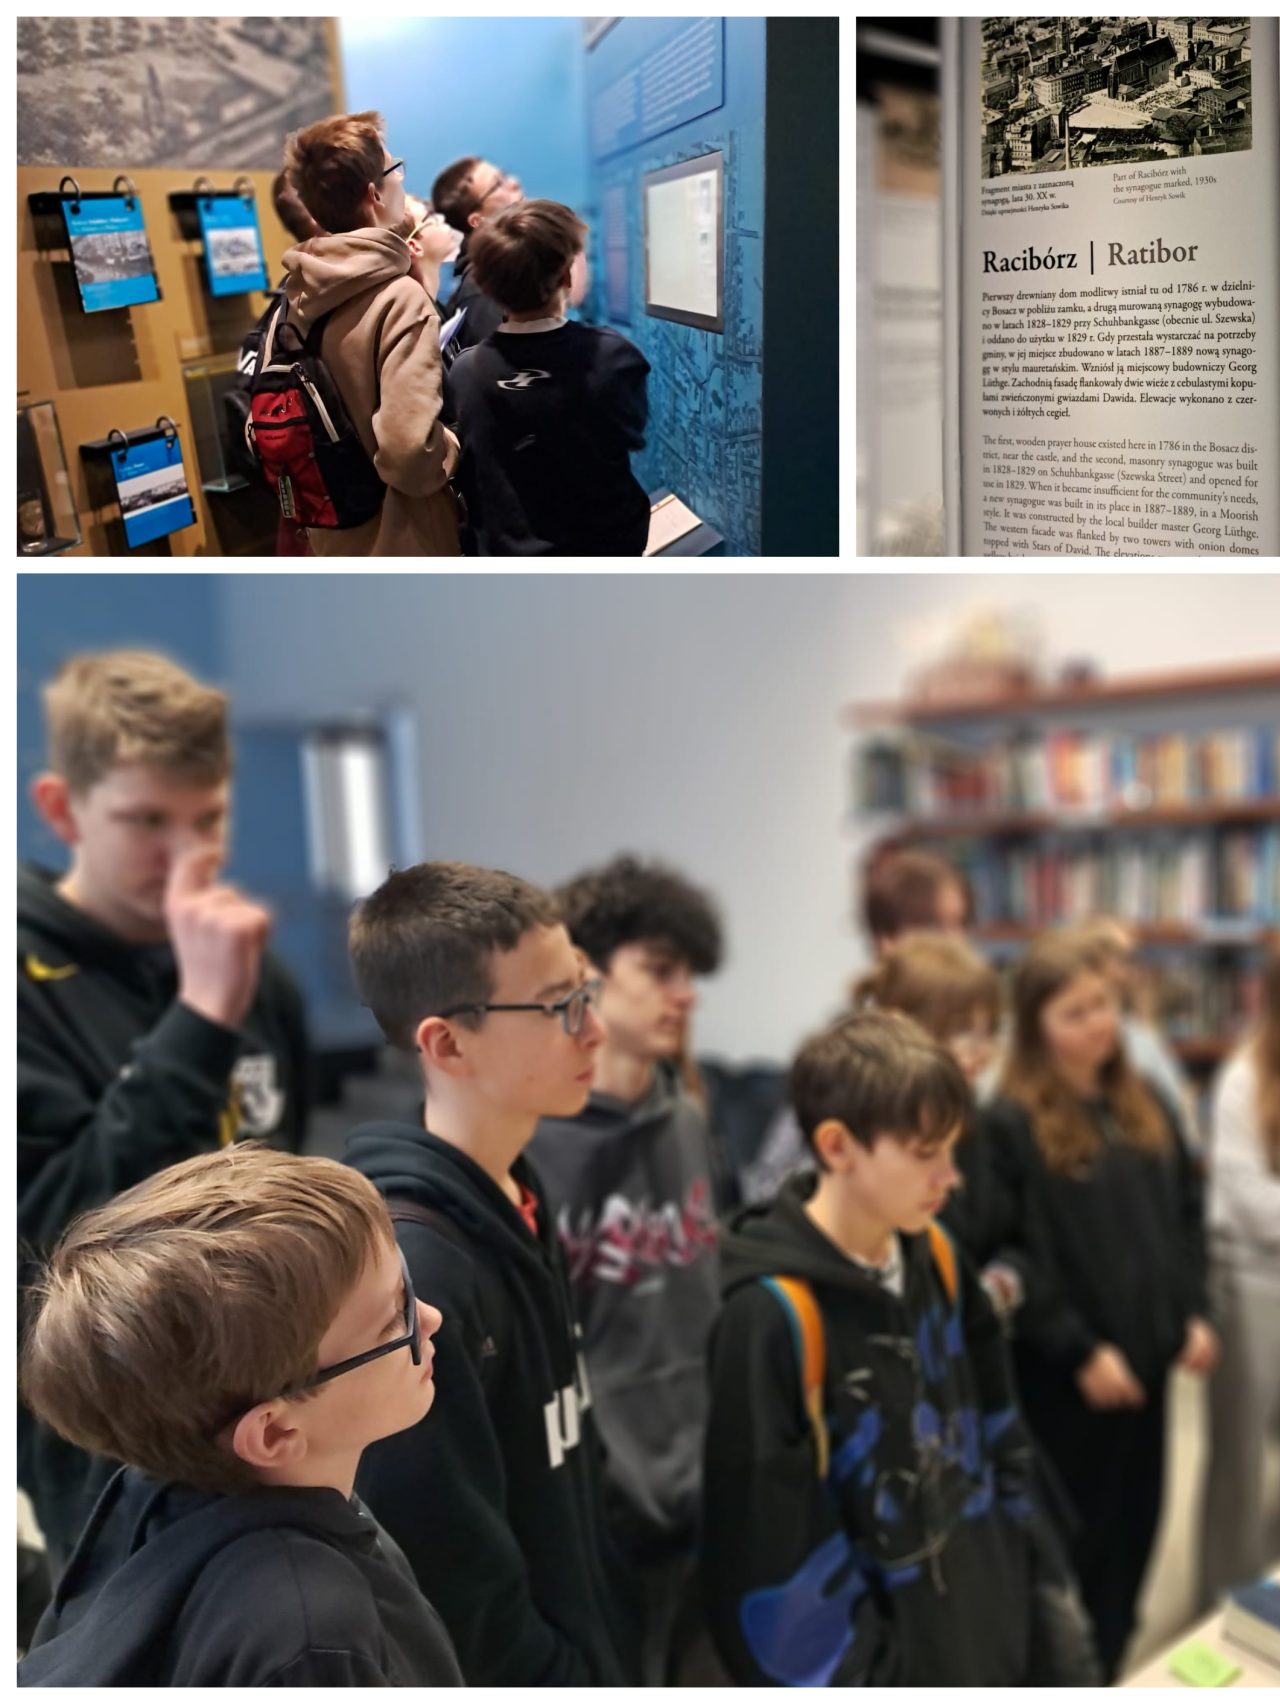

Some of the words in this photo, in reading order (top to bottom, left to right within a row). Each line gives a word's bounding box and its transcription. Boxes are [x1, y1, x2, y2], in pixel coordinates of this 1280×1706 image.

[1112, 171, 1128, 182] Part
[1136, 168, 1169, 179] Racibórz
[1169, 165, 1188, 176] with
[1112, 184, 1125, 193] the
[1125, 182, 1162, 194] synagogue
[1162, 177, 1194, 188] marked,
[1194, 174, 1217, 186] 1930s
[983, 246, 1078, 274] Racibórz
[1108, 238, 1199, 268] Ratibor
[1058, 289, 1077, 298] dom
[1080, 287, 1119, 297] modlitwy
[1121, 287, 1147, 296] istniał
[1150, 286, 1160, 295] tu
[1162, 285, 1174, 294] od
[1177, 282, 1199, 293] 1786
[1221, 282, 1256, 291] dzielni-
[1057, 303, 1085, 313] zamku,
[1093, 304, 1117, 314] drugą
[1118, 302, 1162, 312] murowaną
[1163, 301, 1202, 312] synagogę
[1204, 298, 1256, 309] wybudowa-
[1073, 320, 1091, 330] przy
[1093, 318, 1160, 328] Schuhbankgasse
[1162, 315, 1200, 328] (obecnie
[1201, 315, 1213, 324] ul.
[1215, 313, 1256, 324] Szewska)
[1067, 332, 1088, 343] 1829
[1097, 332, 1115, 342] Gdy
[1117, 331, 1154, 342] przestała
[1156, 329, 1202, 341] wystarczać
[1203, 332, 1215, 340] na
[1217, 330, 1257, 340] potrzeby
[1058, 348, 1105, 358] zbudowano
[1116, 347, 1141, 357] latach
[1144, 345, 1194, 356] 1887–1889
[1195, 348, 1220, 356] nową
[1222, 347, 1256, 358] synago-
[1082, 362, 1114, 372] Wzniósł
[1116, 365, 1124, 374] ją
[1126, 365, 1170, 374] miejscowy
[1172, 361, 1226, 374] budowniczy
[1228, 362, 1258, 373] Georg
[1053, 379, 1078, 390] fasadę
[1079, 378, 1123, 390] flankowały
[1124, 379, 1144, 387] dwie
[1146, 380, 1169, 388] wieże
[1176, 379, 1229, 388] cebulastymi
[1230, 377, 1257, 389] kopu-
[1056, 393, 1100, 404] gwiazdami
[1102, 393, 1136, 403] Dawida.
[1140, 393, 1176, 406] Elewacje
[1179, 394, 1225, 405] wykonano
[1235, 396, 1257, 404] czer-
[1046, 409, 1070, 420] cegieł.
[1047, 440, 1072, 450] prayer
[1073, 438, 1097, 448] house
[1097, 440, 1126, 449] existed
[1128, 441, 1146, 450] here
[1148, 442, 1156, 450] in
[1158, 440, 1180, 451] 1786
[1192, 443, 1208, 452] the
[1208, 442, 1240, 453] Bosacz
[1240, 445, 1258, 454] dis-
[1036, 452, 1060, 463] castle,
[1062, 455, 1077, 463] and
[1079, 455, 1093, 463] the
[1095, 456, 1128, 465] second,
[1130, 458, 1166, 468] masonry
[1167, 459, 1214, 470] synagogue
[1218, 461, 1234, 470] was
[1236, 461, 1258, 471] built
[1049, 467, 1115, 480] Schuhbankgasse
[1116, 470, 1156, 482] (Szewska
[1157, 473, 1188, 485] Street)
[1189, 475, 1206, 485] and
[1208, 475, 1242, 488] opened
[1244, 477, 1259, 488] for
[1061, 482, 1092, 494] became
[1093, 486, 1139, 497] insufficient
[1141, 487, 1154, 498] for
[1156, 489, 1170, 499] the
[1170, 492, 1229, 503] community's
[1230, 494, 1259, 506] needs,
[1063, 498, 1084, 509] built
[1085, 502, 1094, 510] in
[1096, 500, 1107, 511] its
[1108, 501, 1130, 512] place
[1132, 505, 1142, 513] in
[1145, 504, 1198, 517] 1887–1889,
[1198, 509, 1209, 518] in
[1220, 509, 1260, 521] Moorish
[1076, 514, 1087, 525] by
[1088, 515, 1103, 526] the
[1105, 516, 1125, 528] local
[1127, 520, 1158, 530] builder
[1161, 524, 1191, 533] master
[1192, 525, 1222, 537] Georg
[1224, 528, 1260, 540] Lüthge.
[1031, 525, 1056, 537] facade
[1076, 529, 1106, 542] flanked
[1109, 534, 1120, 542] by
[1123, 536, 1140, 544] two
[1142, 536, 1173, 547] towers
[1174, 540, 1195, 549] with
[1198, 543, 1228, 552] onion
[1230, 545, 1260, 556] domes
[1032, 541, 1052, 552] Stars
[1064, 544, 1094, 556] David.
[1095, 546, 1111, 554] The
